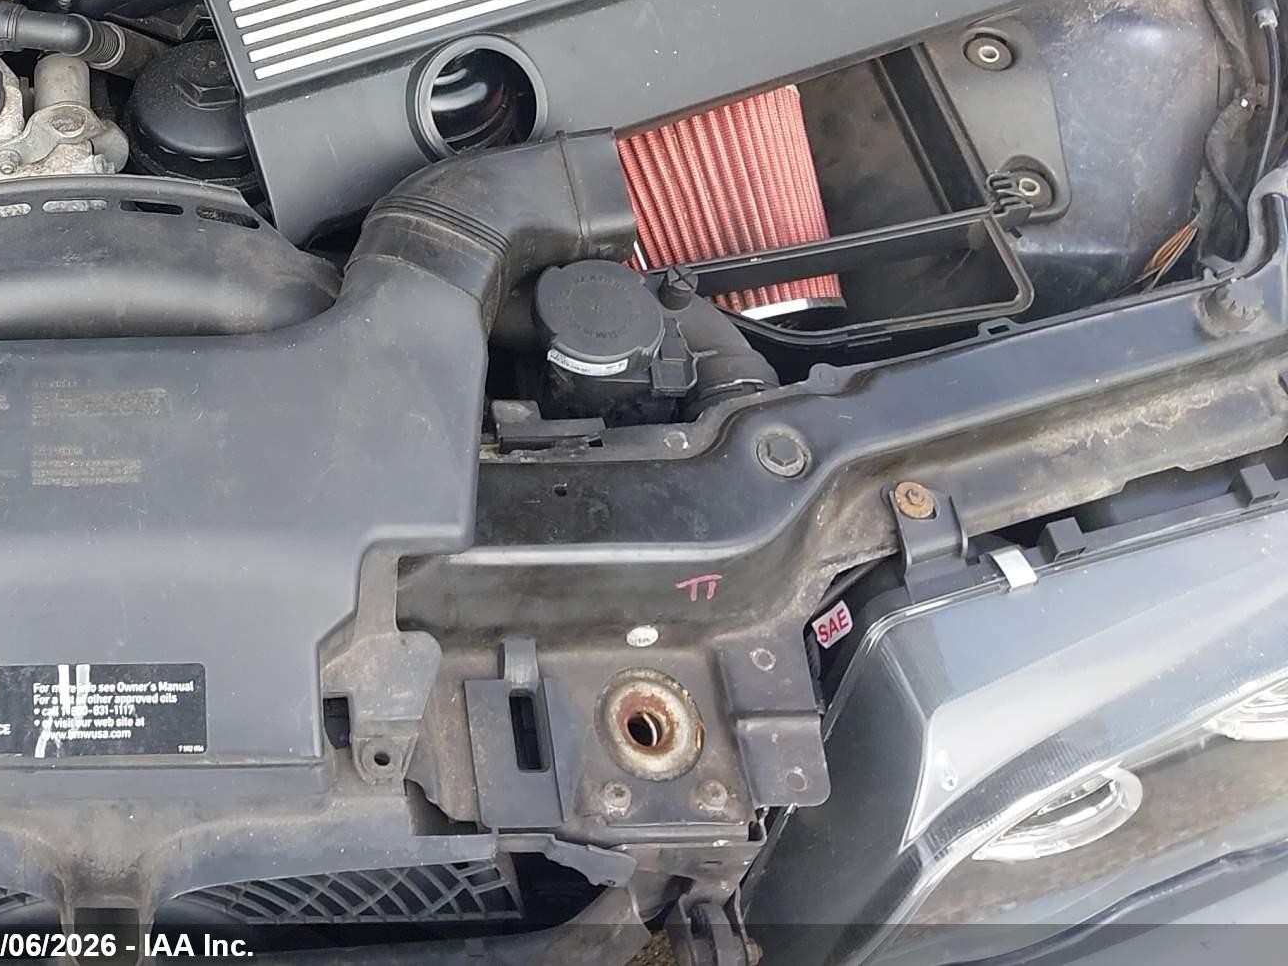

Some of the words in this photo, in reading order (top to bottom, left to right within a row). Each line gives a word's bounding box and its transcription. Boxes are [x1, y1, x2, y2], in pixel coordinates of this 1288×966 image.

[818, 608, 849, 643] SAE
[33, 683, 50, 693] For
[98, 684, 115, 693] see
[158, 681, 194, 692] Manual
[33, 694, 50, 705] For
[51, 696, 59, 705] a
[88, 694, 113, 705] other
[114, 694, 158, 705] approved
[160, 693, 178, 704] oils
[41, 705, 59, 716] call
[94, 717, 114, 727] web
[115, 716, 134, 727] site
[135, 716, 145, 727] at
